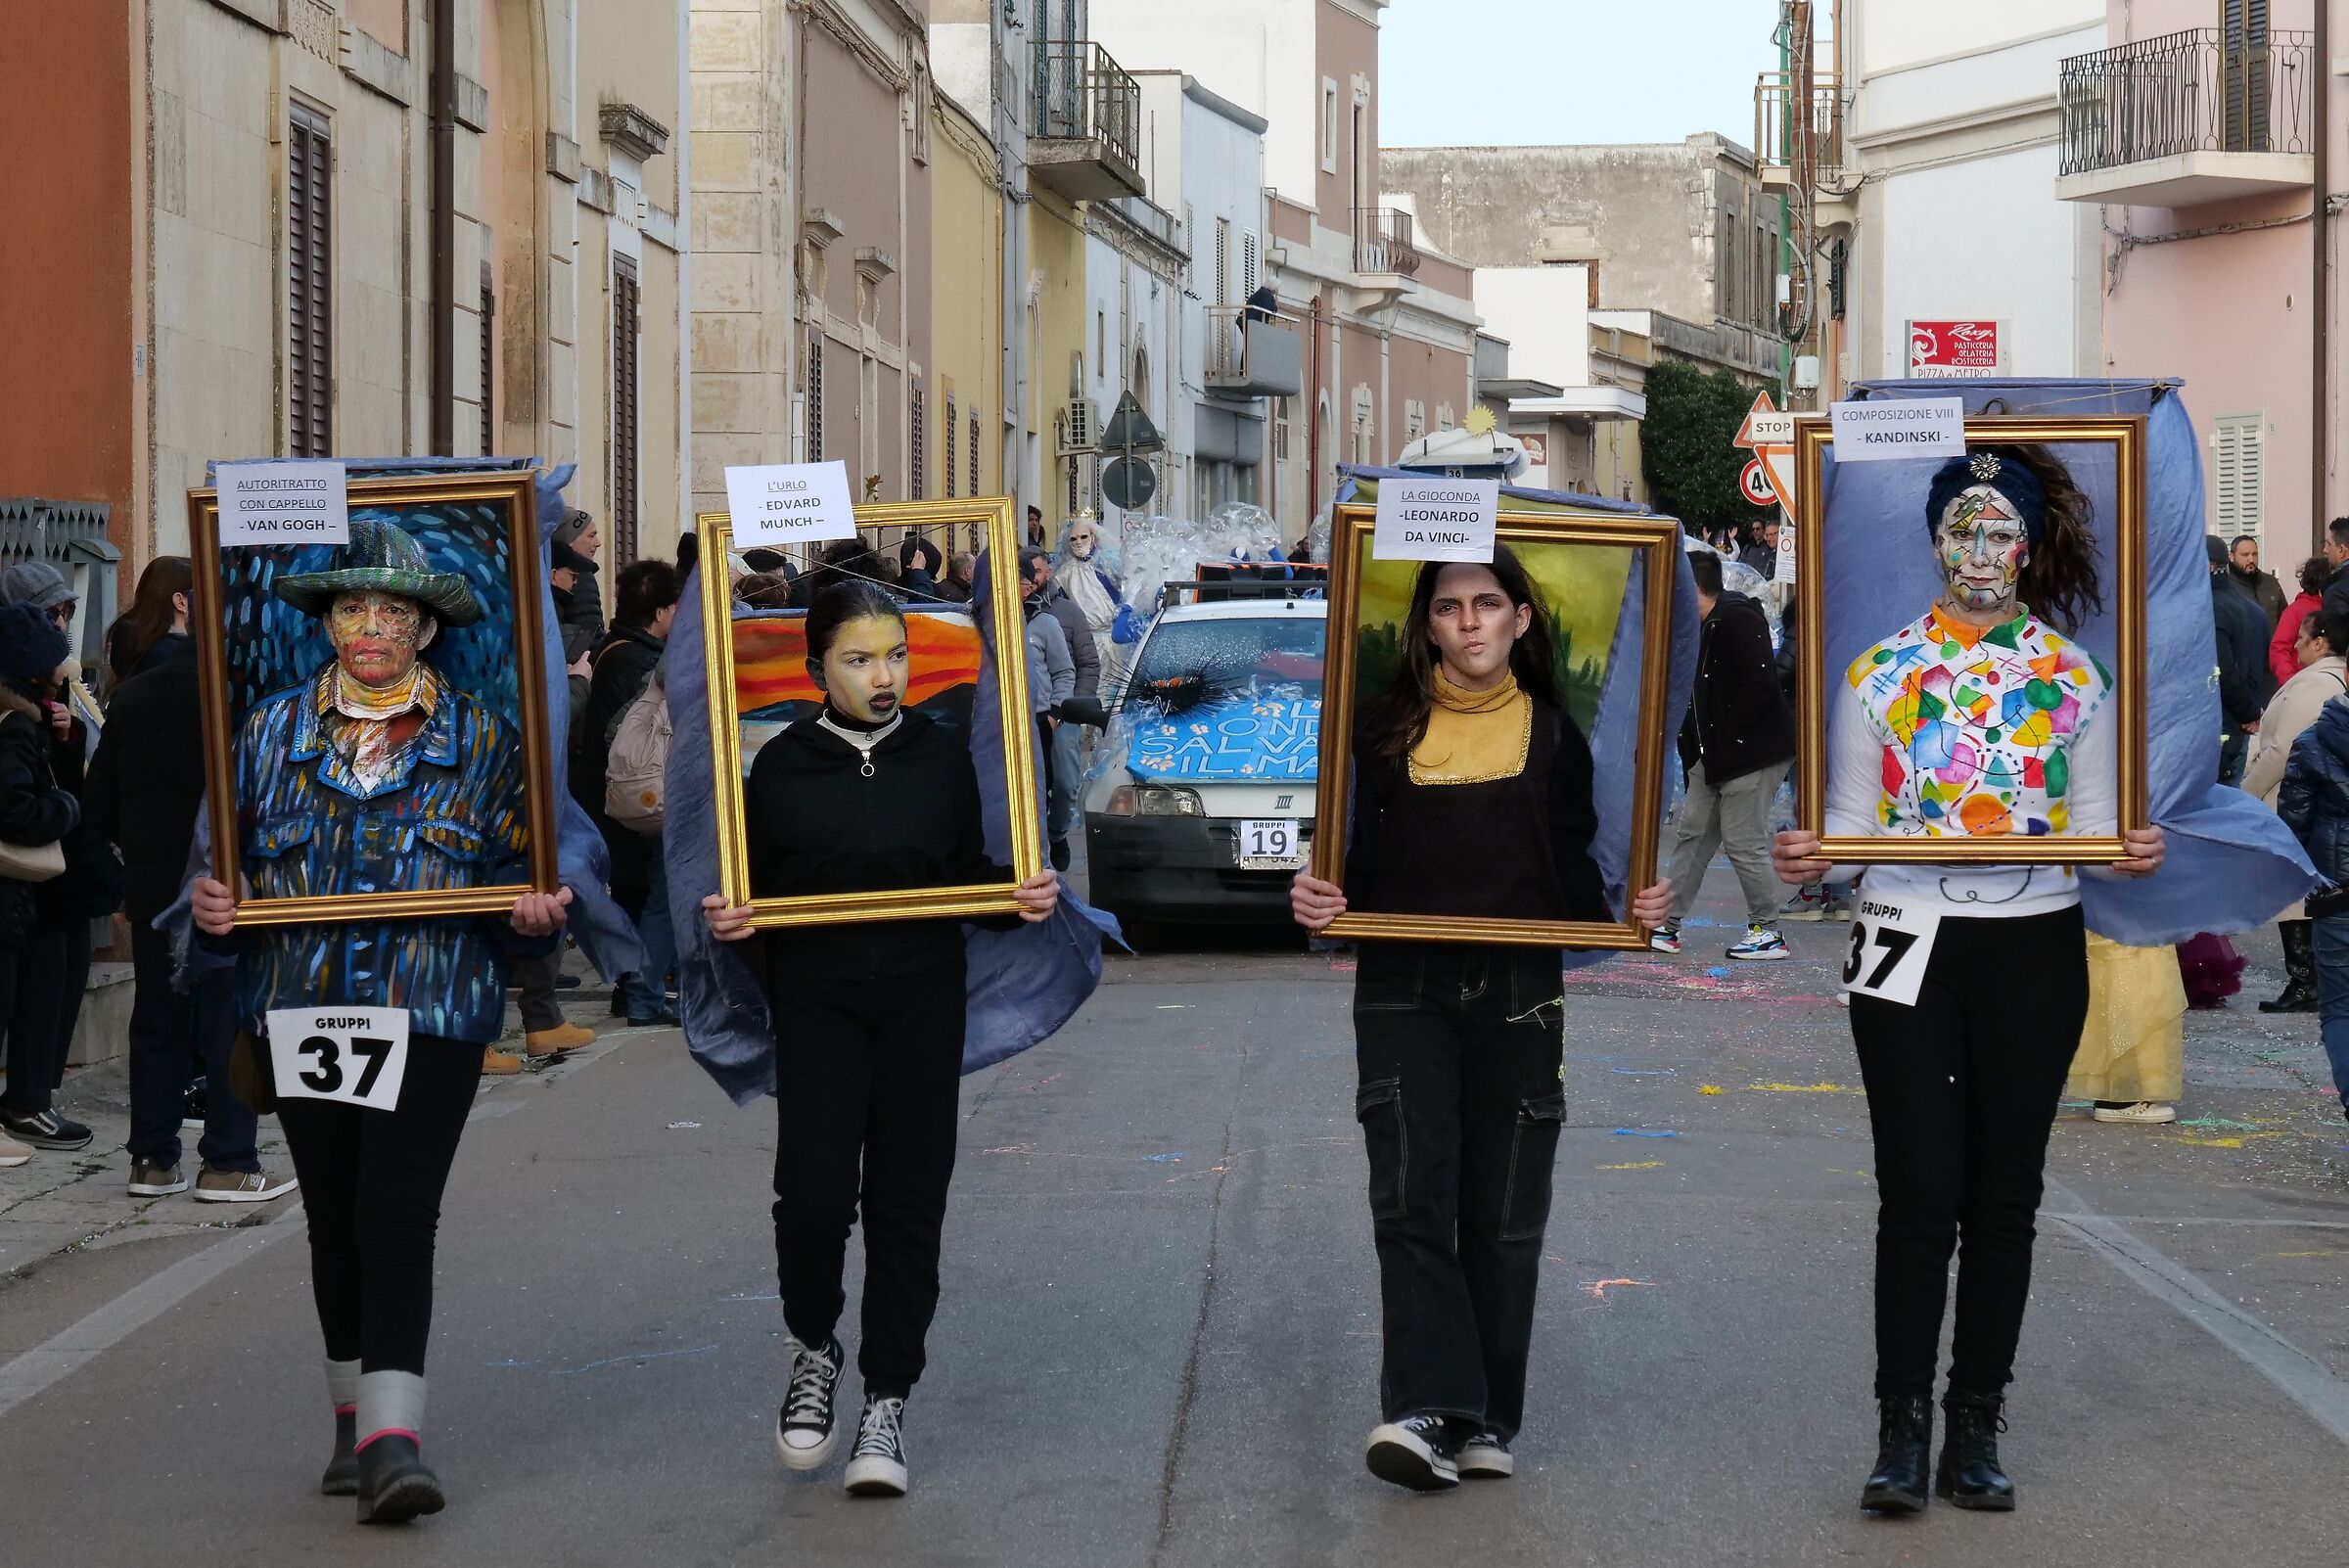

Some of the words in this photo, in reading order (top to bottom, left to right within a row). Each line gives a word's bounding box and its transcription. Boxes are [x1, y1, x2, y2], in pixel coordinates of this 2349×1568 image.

[1917, 368, 1944, 378] PIZZA
[1842, 409, 1932, 421] COMPOSIZIONE
[1934, 408, 1954, 419] VIII
[1756, 422, 1791, 433] STOP
[1865, 431, 1941, 443] KANDINSKI
[237, 479, 327, 489] AUTORITRATTO
[1402, 490, 1415, 500] LA
[1418, 491, 1481, 502] GIOCONDA
[239, 499, 265, 509] CON
[268, 498, 326, 509] CAPPELLO
[766, 497, 821, 511] EDVARD
[1400, 509, 1479, 523] -LEONARDO
[247, 521, 278, 531] VAN
[282, 519, 325, 530] GOGH
[760, 516, 812, 530] MUNCH
[1405, 530, 1424, 542] DA
[1178, 755, 1234, 774] IL
[1251, 830, 1288, 855] 19
[1861, 900, 1903, 921] GRUPPI
[1842, 921, 1920, 991] 37
[315, 1017, 371, 1030] GRUPPI
[298, 1036, 394, 1099] 37
